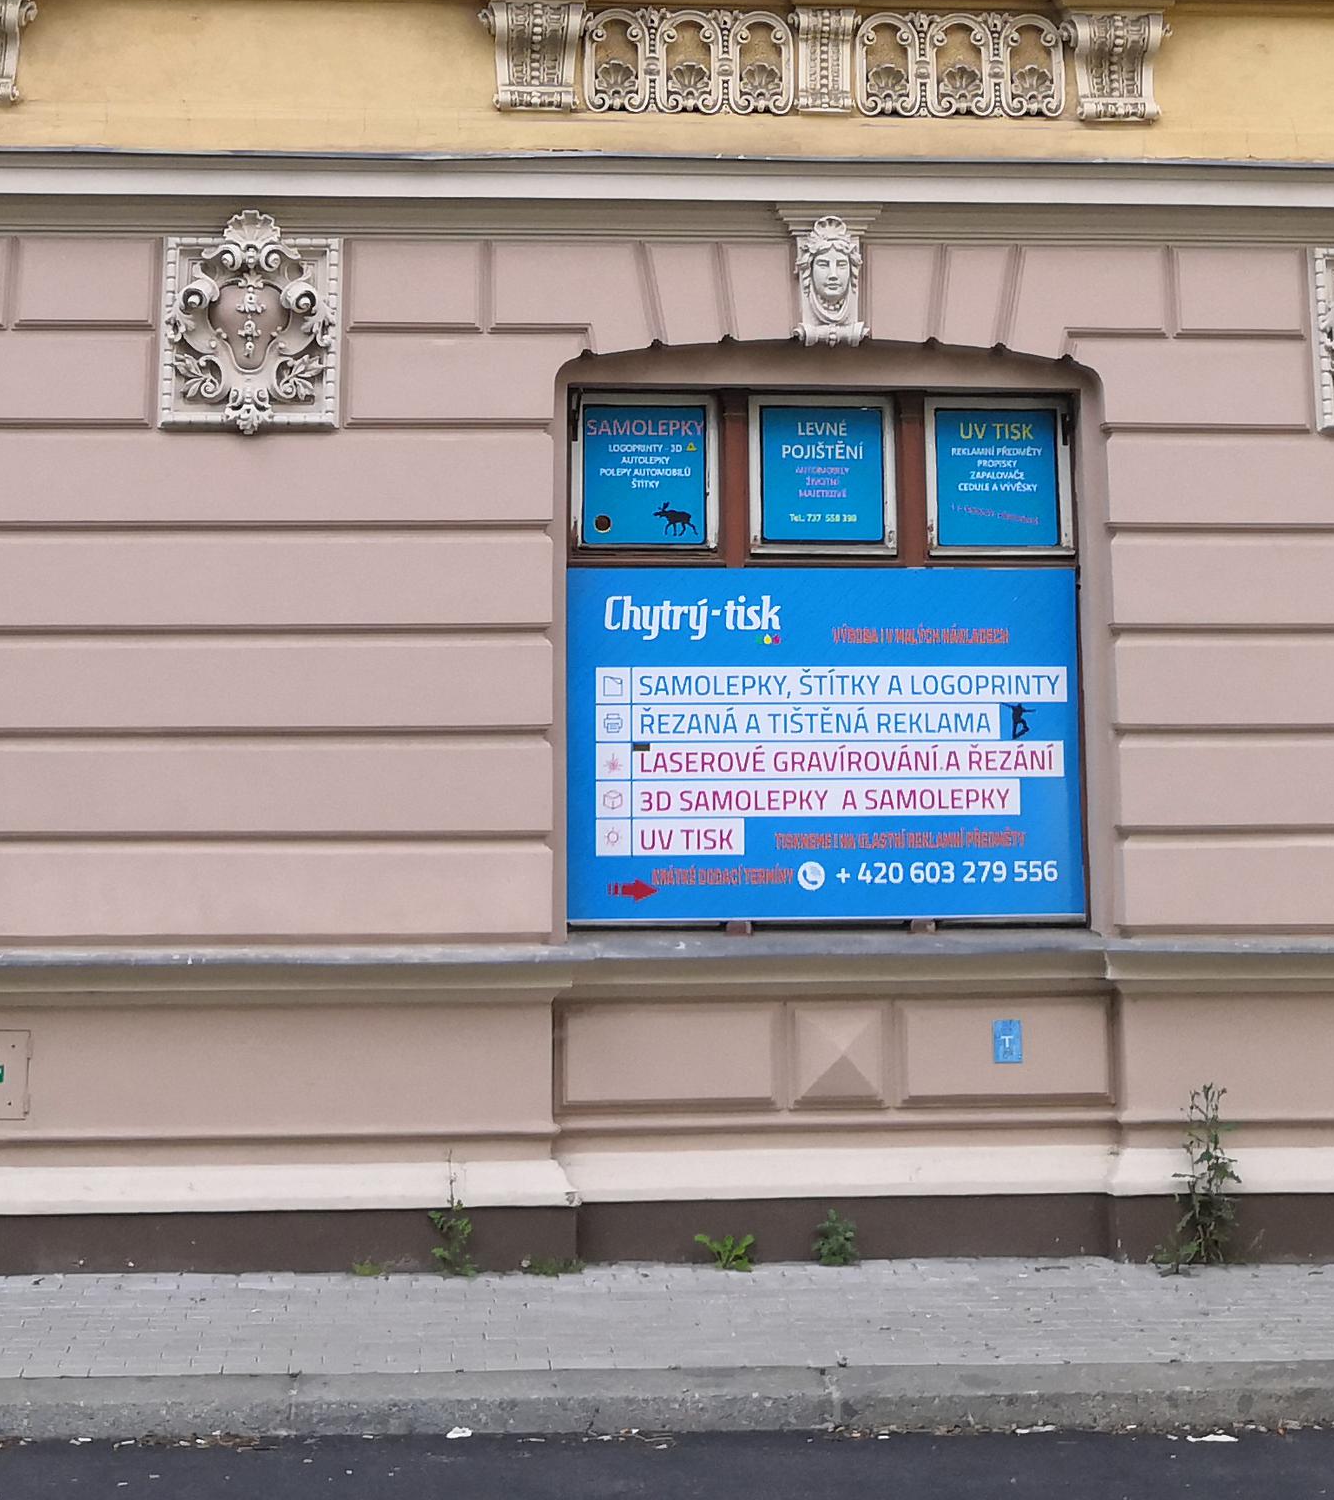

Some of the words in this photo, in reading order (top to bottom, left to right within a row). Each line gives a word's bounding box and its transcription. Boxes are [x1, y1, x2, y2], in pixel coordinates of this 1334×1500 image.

[586, 419, 704, 436] SAMOLEPKY
[797, 419, 848, 436] LEVNÉ
[960, 423, 986, 439] UV
[992, 423, 1034, 440] TISK
[608, 444, 663, 453] LOGOPRINTY
[670, 444, 682, 453] 3D
[781, 440, 864, 459] POJIŠTĚNÍ
[599, 468, 631, 477] POLEPY
[970, 469, 1025, 480] ZAPALOVAČE
[958, 482, 990, 491] CEDULE
[992, 483, 998, 491] A
[604, 595, 781, 640] Chytrý-tisk
[639, 674, 791, 699] SAMOLEPKY,
[799, 668, 881, 696] ŠTÍTKY
[887, 675, 903, 696] A
[911, 673, 1060, 696] LOGOPRINTY
[640, 706, 737, 734] ŘEZANÁ
[745, 713, 761, 734] A
[769, 705, 869, 734] TIŠTĚNÁ
[877, 712, 992, 734] REKLAMA
[640, 745, 766, 773] LASEROVÉ
[773, 744, 938, 772] GRAVÍROVÁNÍ
[945, 749, 961, 771] A
[968, 744, 1054, 771] ŘEZÁNÍ
[641, 790, 672, 813] 3D
[679, 789, 828, 812] SAMOLEPKY
[842, 789, 857, 811] A
[865, 788, 1010, 810] SAMOLEPKY
[641, 828, 674, 850] UV
[681, 828, 735, 850] TISK
[858, 861, 904, 884] 420
[910, 861, 955, 884] 603
[963, 861, 1006, 883] 279
[1014, 860, 1059, 882] 556
